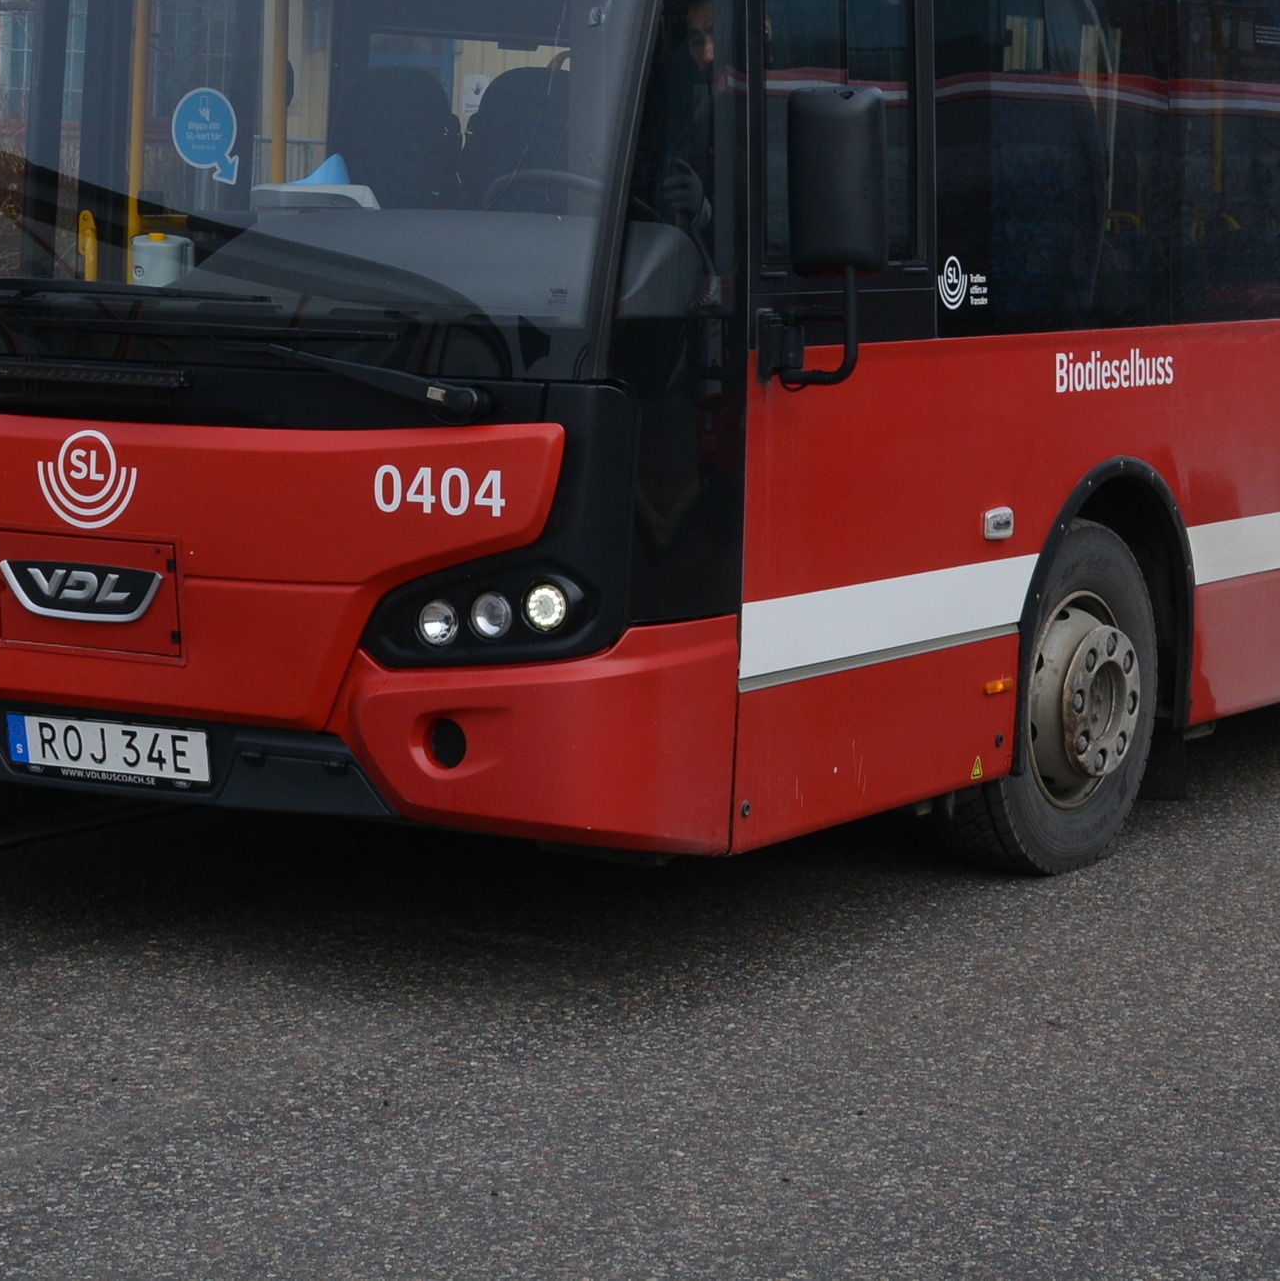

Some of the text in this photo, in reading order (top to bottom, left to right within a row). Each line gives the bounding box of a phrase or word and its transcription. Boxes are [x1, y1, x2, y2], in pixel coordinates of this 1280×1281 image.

[947, 266, 959, 284] SL
[1055, 348, 1174, 393] Biodieselbuss
[70, 448, 105, 481] SL
[373, 464, 506, 518] 0404
[27, 567, 131, 604] VDL
[16, 721, 192, 775] S ROJ 34E
[60, 767, 157, 787] WWW.VDLBUSCOACH.SE
